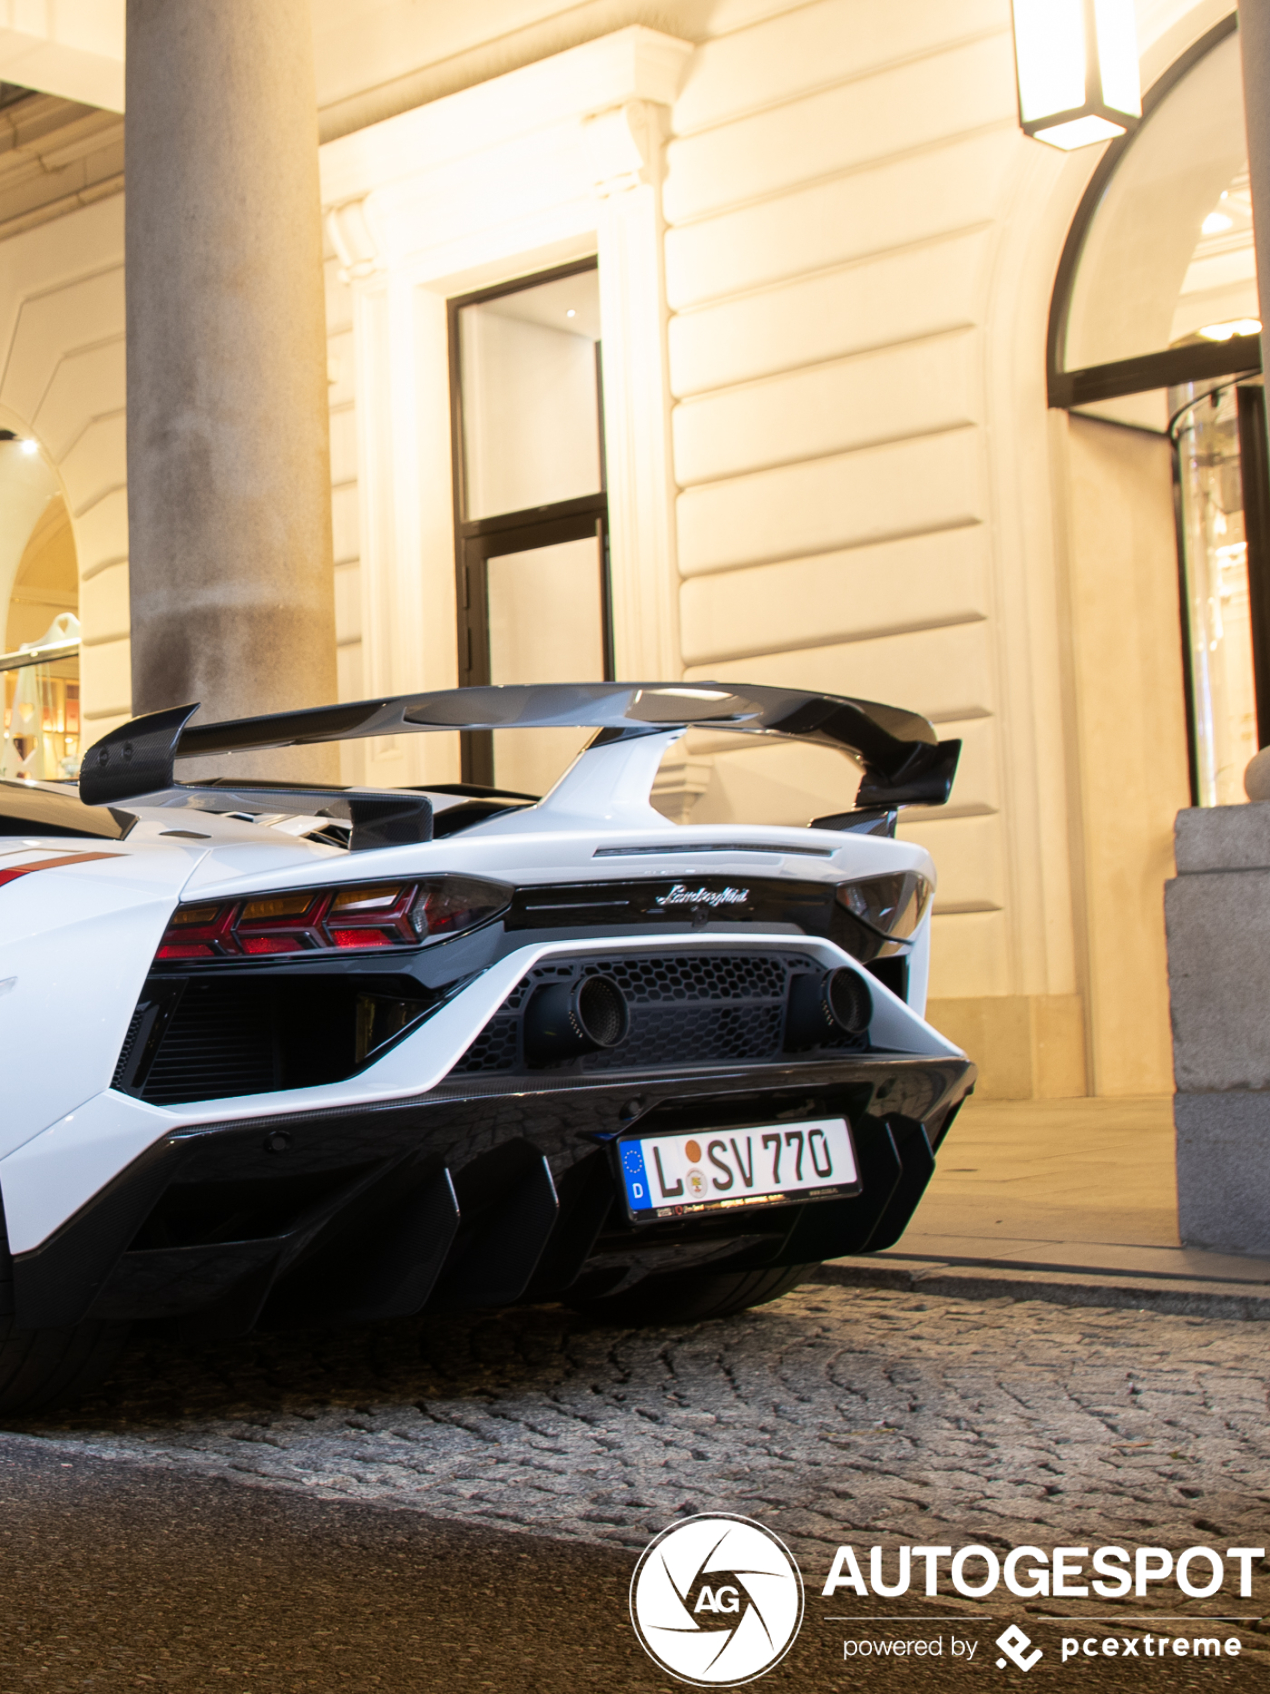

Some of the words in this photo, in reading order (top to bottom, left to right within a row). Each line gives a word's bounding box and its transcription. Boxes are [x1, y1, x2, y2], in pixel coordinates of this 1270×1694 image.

[653, 1146, 684, 1198] L
[762, 1129, 833, 1184] 770
[632, 1183, 643, 1198] D
